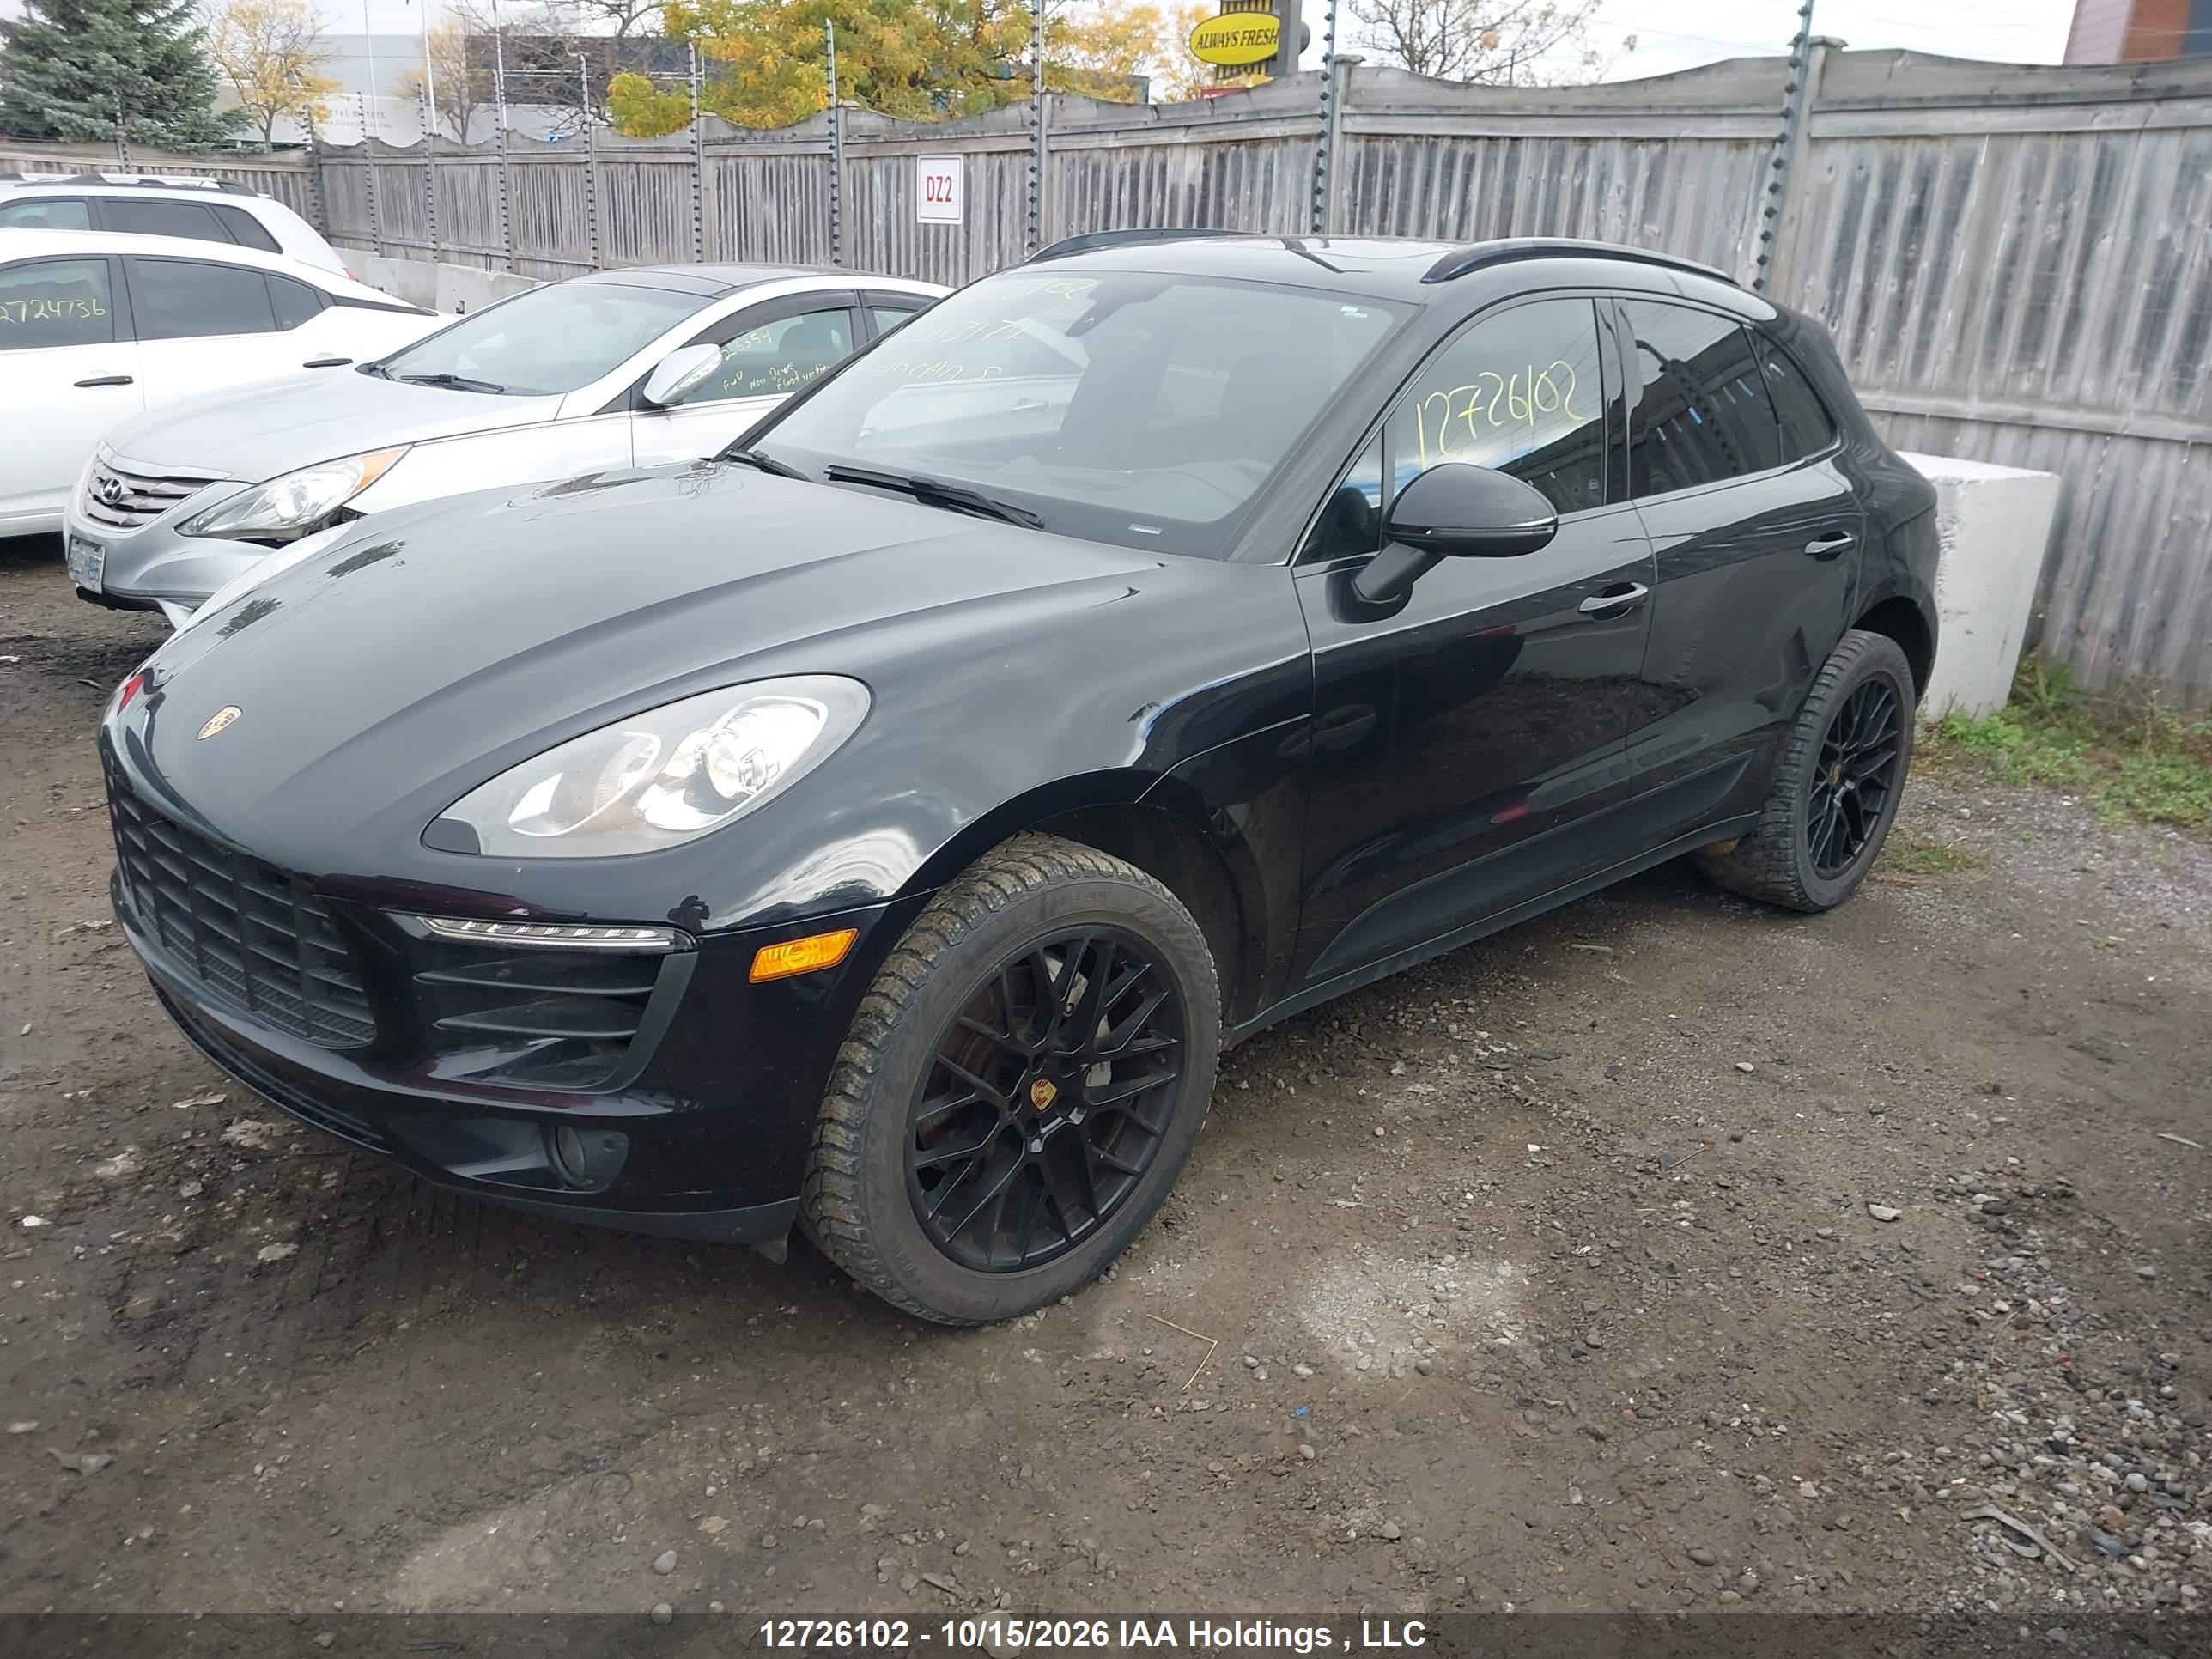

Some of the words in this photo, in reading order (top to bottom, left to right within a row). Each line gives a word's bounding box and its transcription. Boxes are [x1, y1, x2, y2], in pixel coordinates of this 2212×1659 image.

[1195, 30, 1241, 50] ALWAYS
[1240, 27, 1279, 46] FRESH
[927, 175, 952, 203] DZ2
[1416, 359, 1585, 471] 12726102
